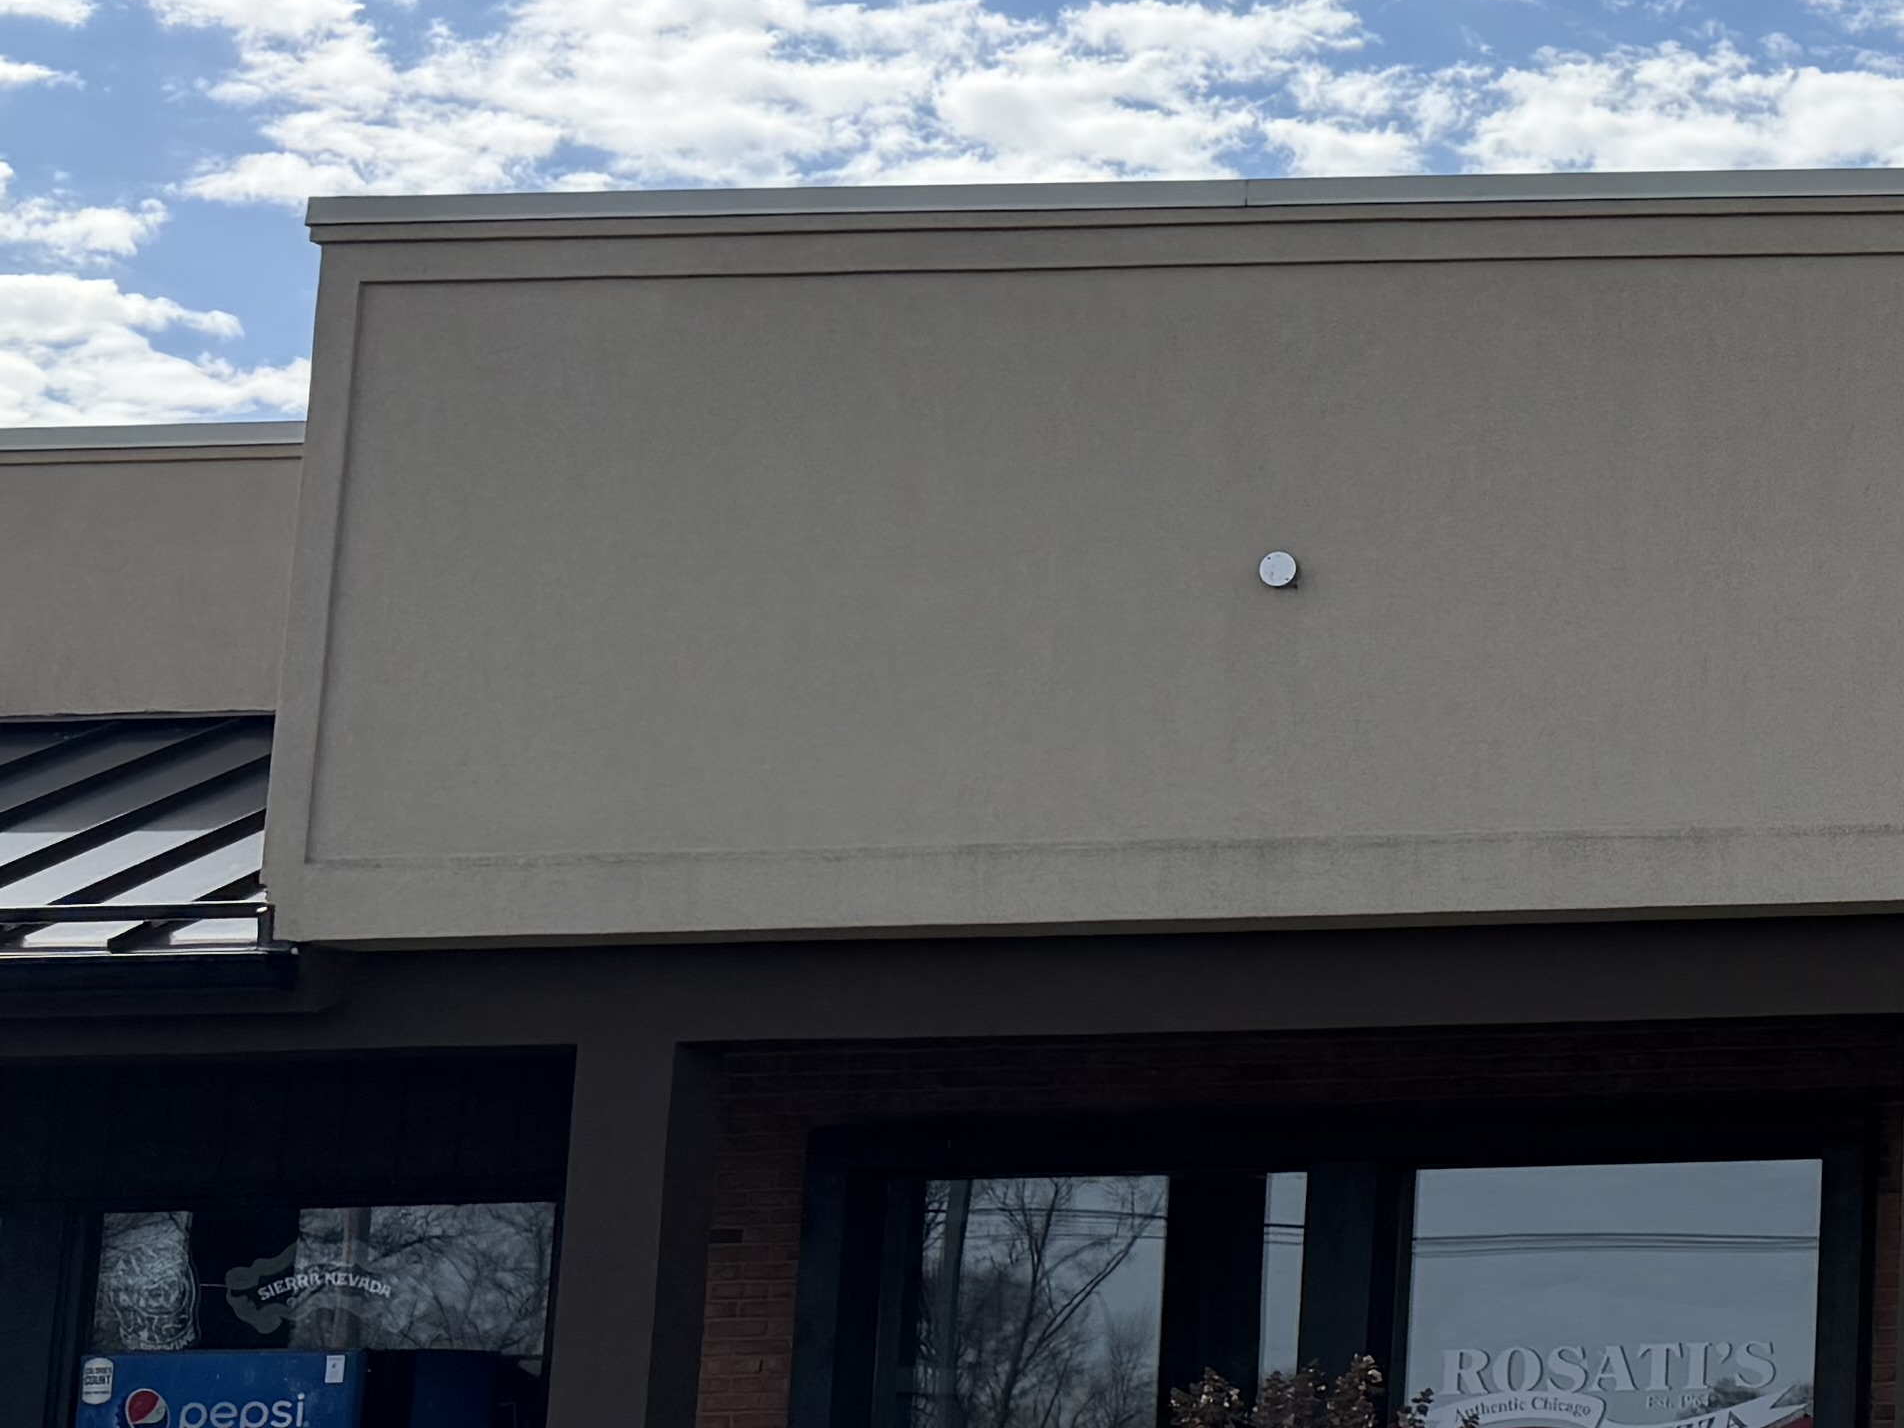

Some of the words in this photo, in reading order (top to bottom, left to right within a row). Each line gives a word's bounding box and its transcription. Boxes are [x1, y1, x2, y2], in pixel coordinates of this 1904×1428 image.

[257, 1273, 322, 1301] SIERRA
[324, 1272, 392, 1298] NEVADA
[1442, 1340, 1778, 1394] ROSATI'S
[1454, 1396, 1526, 1424] Authentic
[1531, 1396, 1592, 1418] Chicago
